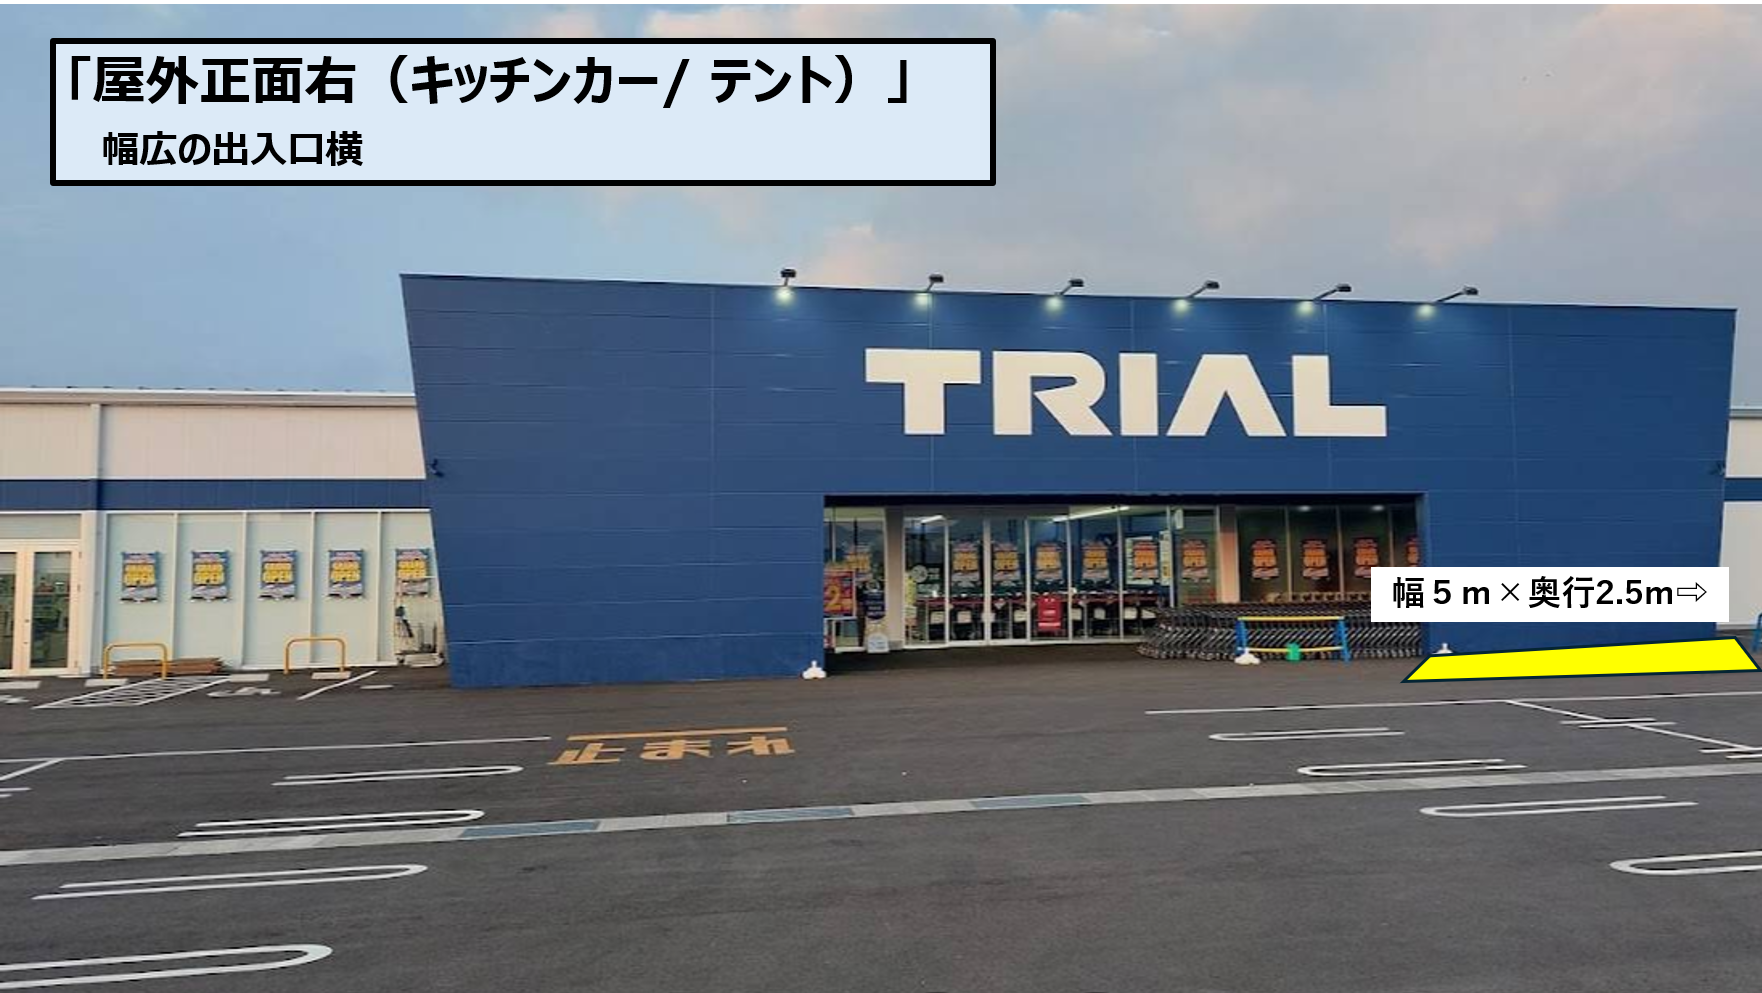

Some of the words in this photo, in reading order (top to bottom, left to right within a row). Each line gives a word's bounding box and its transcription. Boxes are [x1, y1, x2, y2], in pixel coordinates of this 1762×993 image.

[866, 349, 1387, 437] TRIAL
[548, 736, 795, 766] 止まれ
